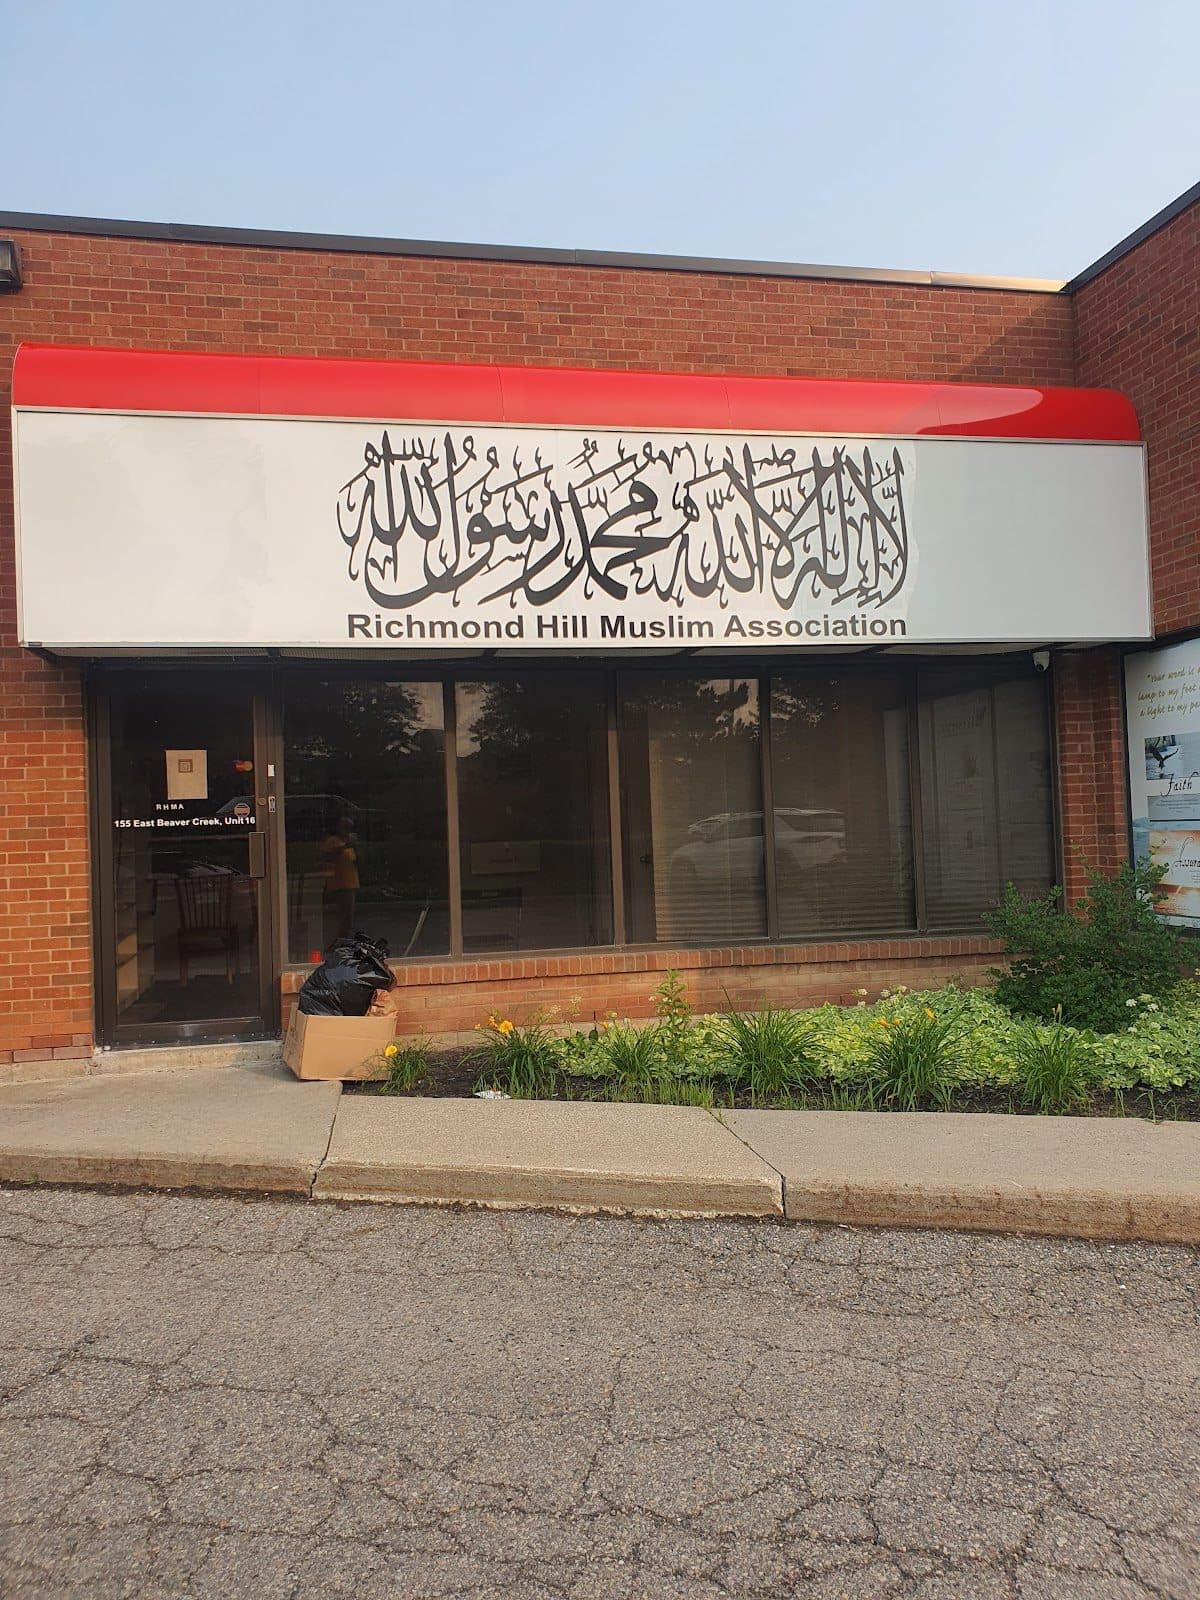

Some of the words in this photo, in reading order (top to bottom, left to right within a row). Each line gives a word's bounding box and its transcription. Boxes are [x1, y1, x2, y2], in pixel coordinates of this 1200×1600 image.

[347, 614, 524, 639] Richmond
[537, 615, 588, 638] Hill
[600, 615, 713, 638] Muslim
[724, 614, 907, 638] Association
[114, 820, 131, 828] 155
[133, 819, 155, 828] East
[156, 818, 190, 828] Beaver
[192, 817, 223, 827] Creek,
[224, 816, 244, 826] Unit
[245, 816, 256, 825] 16
